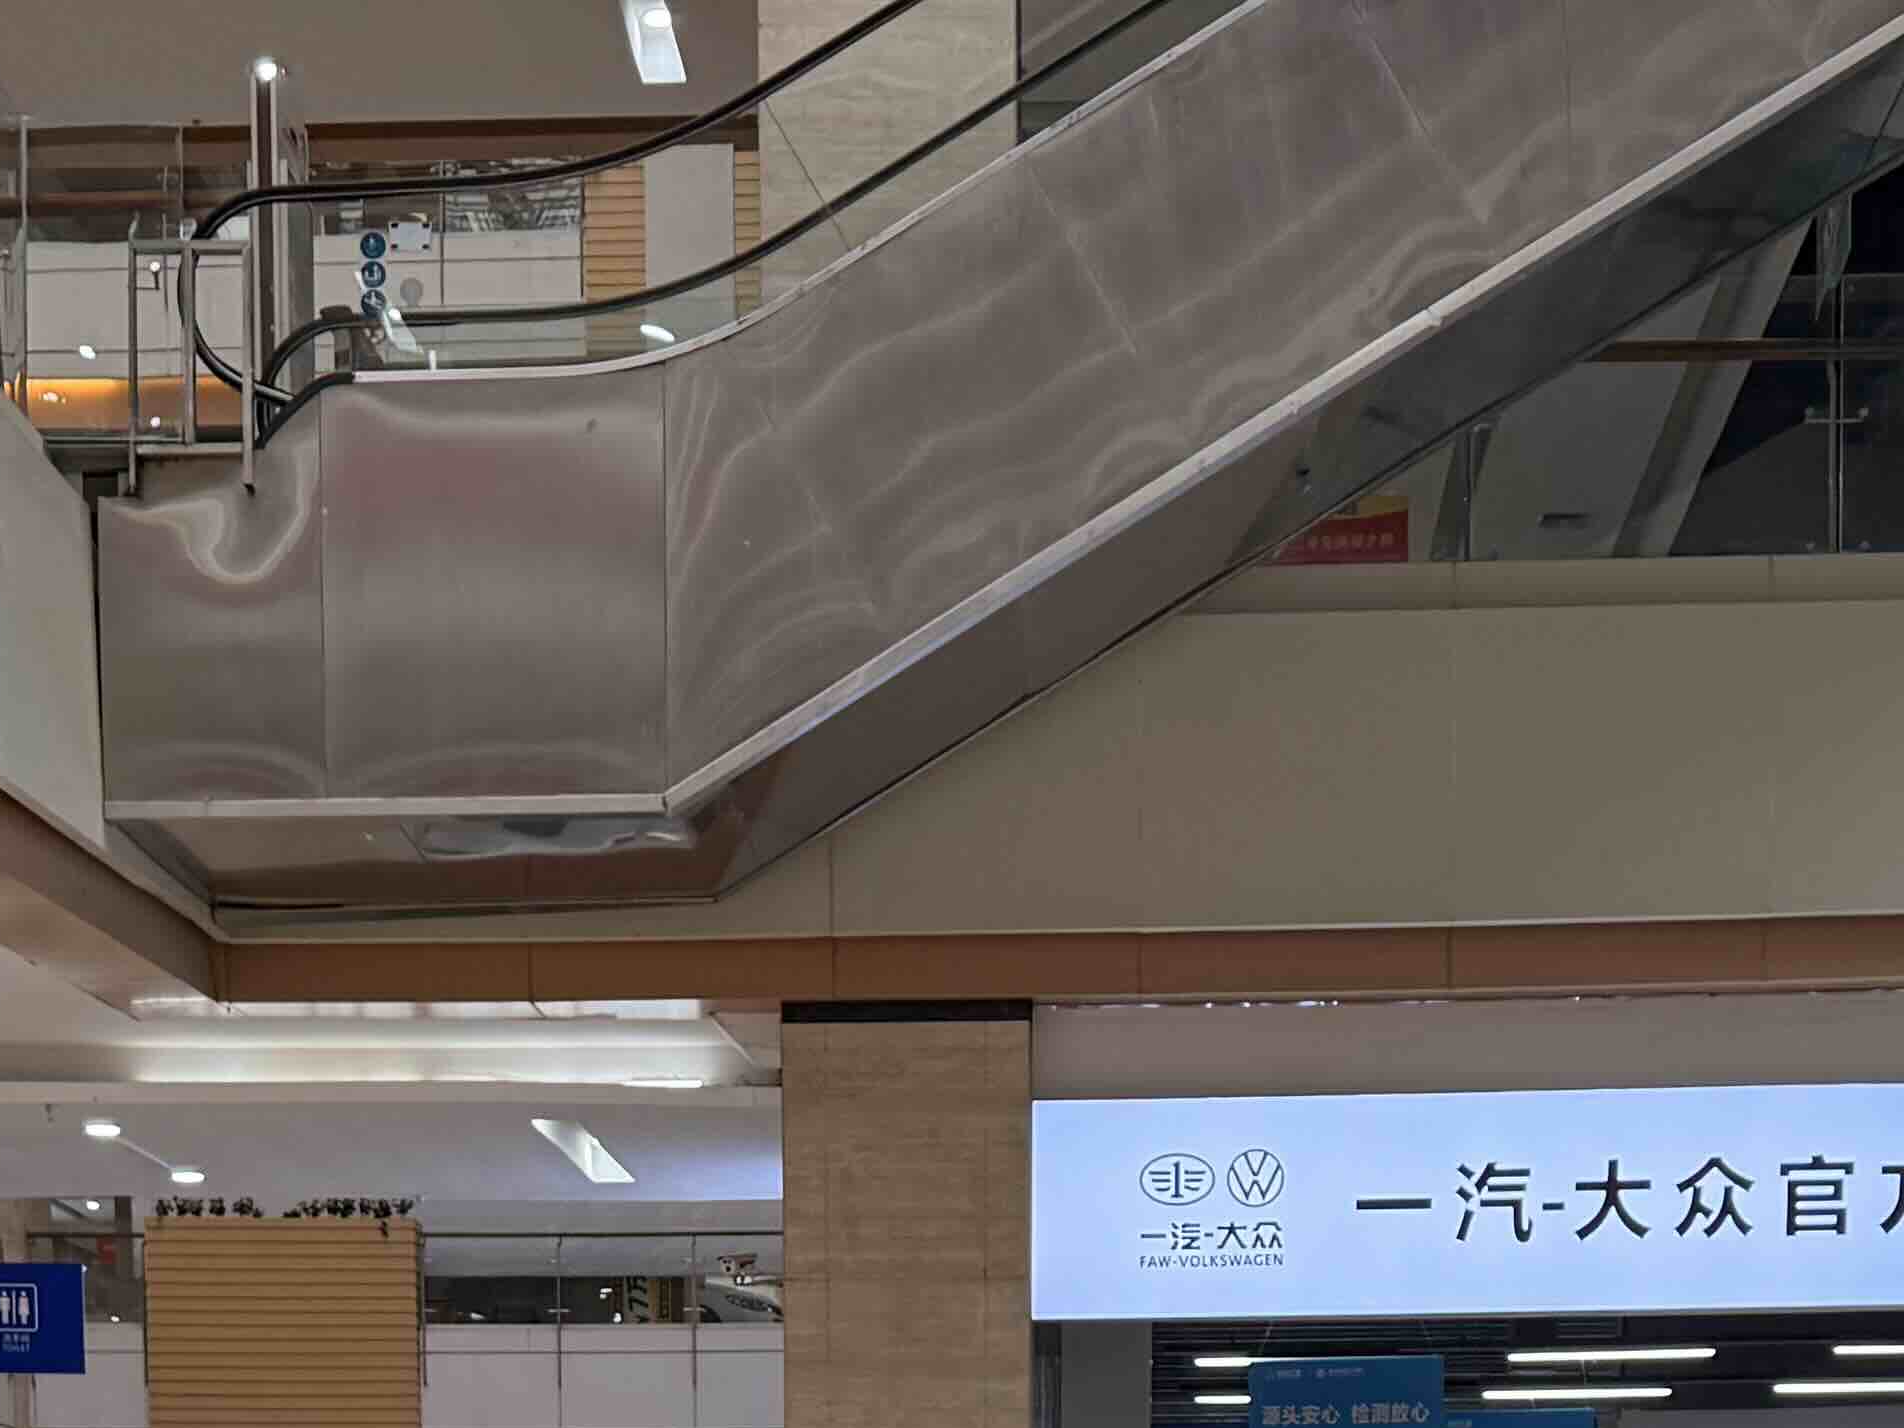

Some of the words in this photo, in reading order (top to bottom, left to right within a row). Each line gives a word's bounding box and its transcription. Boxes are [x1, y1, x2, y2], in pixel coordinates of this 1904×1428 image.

[1140, 1222, 1283, 1251] 一汽-大众
[1139, 1254, 1284, 1269] FAW-VOLKSWAGEN
